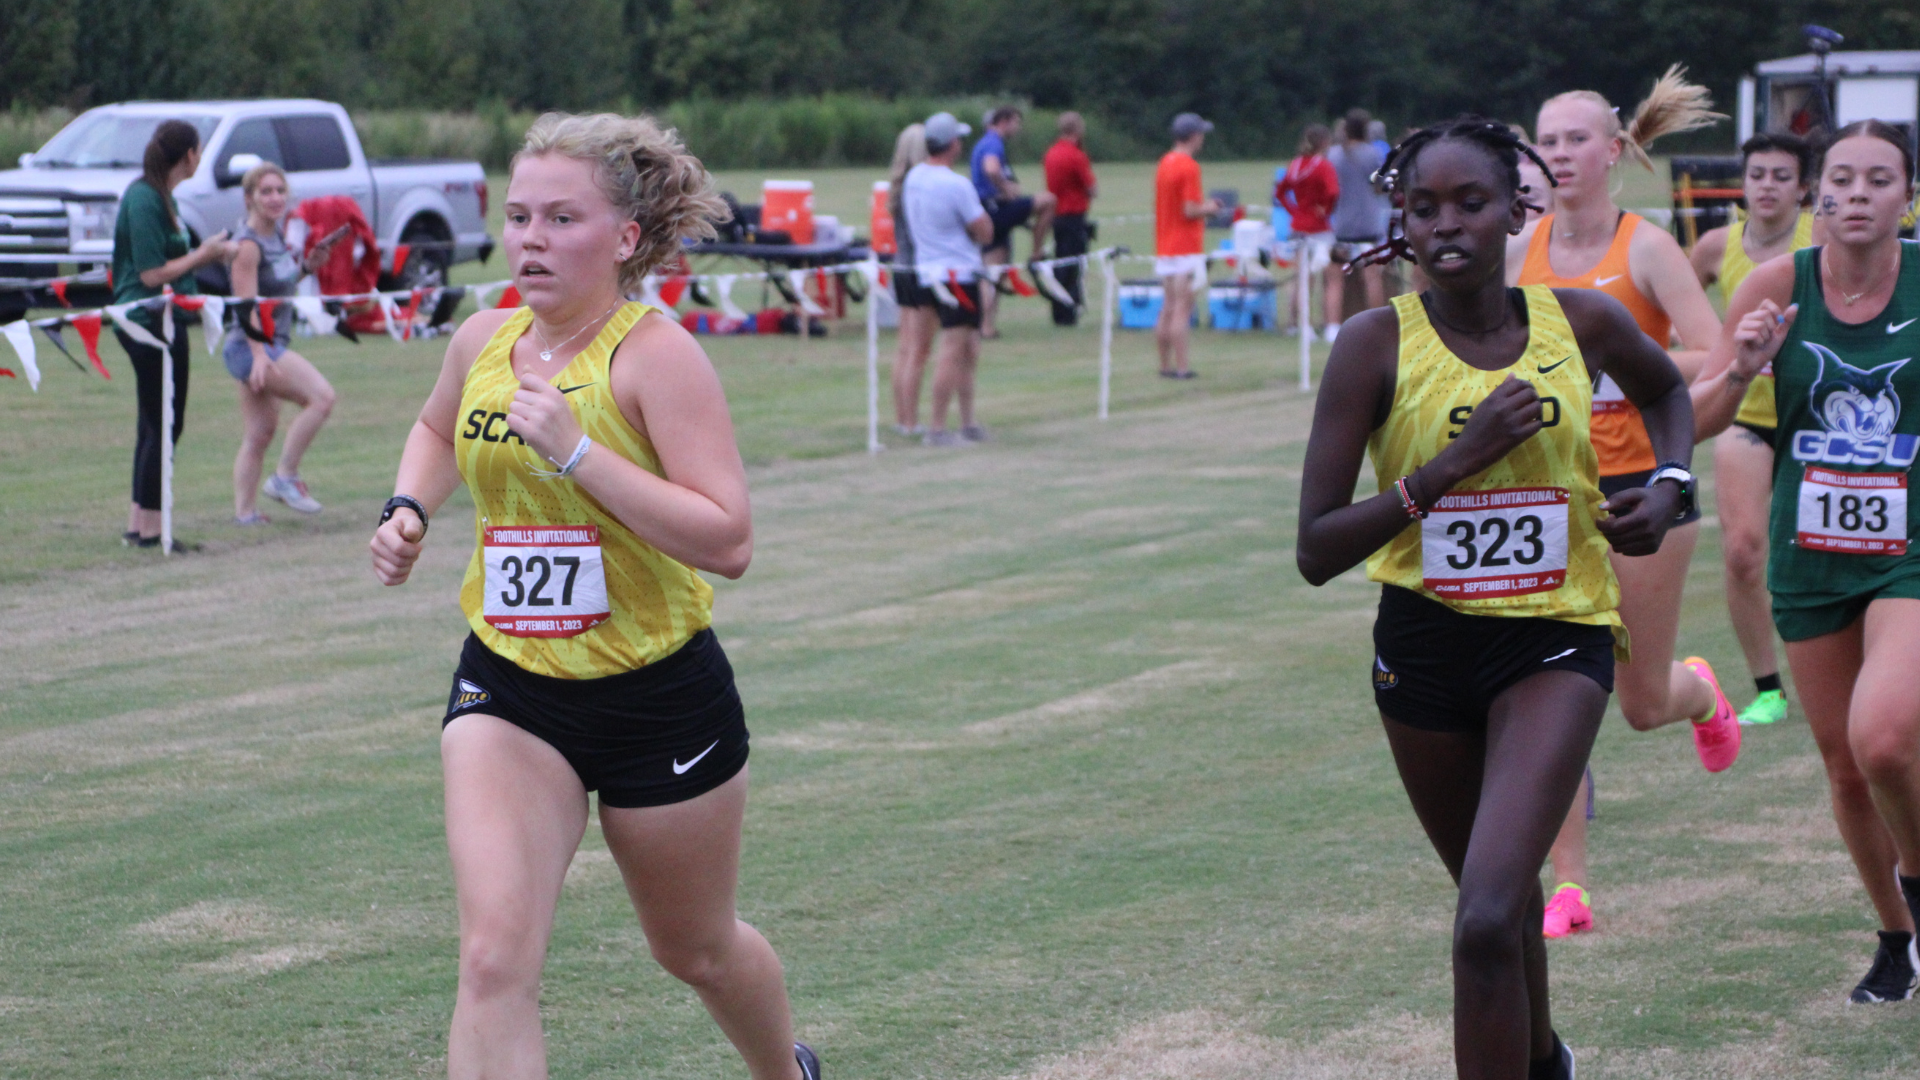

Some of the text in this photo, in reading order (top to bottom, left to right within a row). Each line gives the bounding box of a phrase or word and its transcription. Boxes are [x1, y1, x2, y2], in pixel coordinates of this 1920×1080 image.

[463, 409, 525, 446] SCA
[1448, 396, 1561, 439] SD
[1792, 429, 1920, 467] GCSU
[1811, 471, 1900, 487] FOOTHILLS INVITATIONAL
[1490, 490, 1558, 505] INVITATIONAL
[1817, 491, 1889, 533] 183
[493, 530, 591, 543] FOOTHILLS INVITATIONAL
[1446, 514, 1545, 570] 323
[1825, 538, 1862, 548] SEPTEMBER
[1868, 541, 1885, 550] 2023
[501, 555, 580, 607] 327
[1464, 580, 1511, 593] SEPTEMBER
[1518, 577, 1539, 589] 2023
[515, 620, 556, 631] SEPTEMBER
[563, 619, 582, 630] 2023
